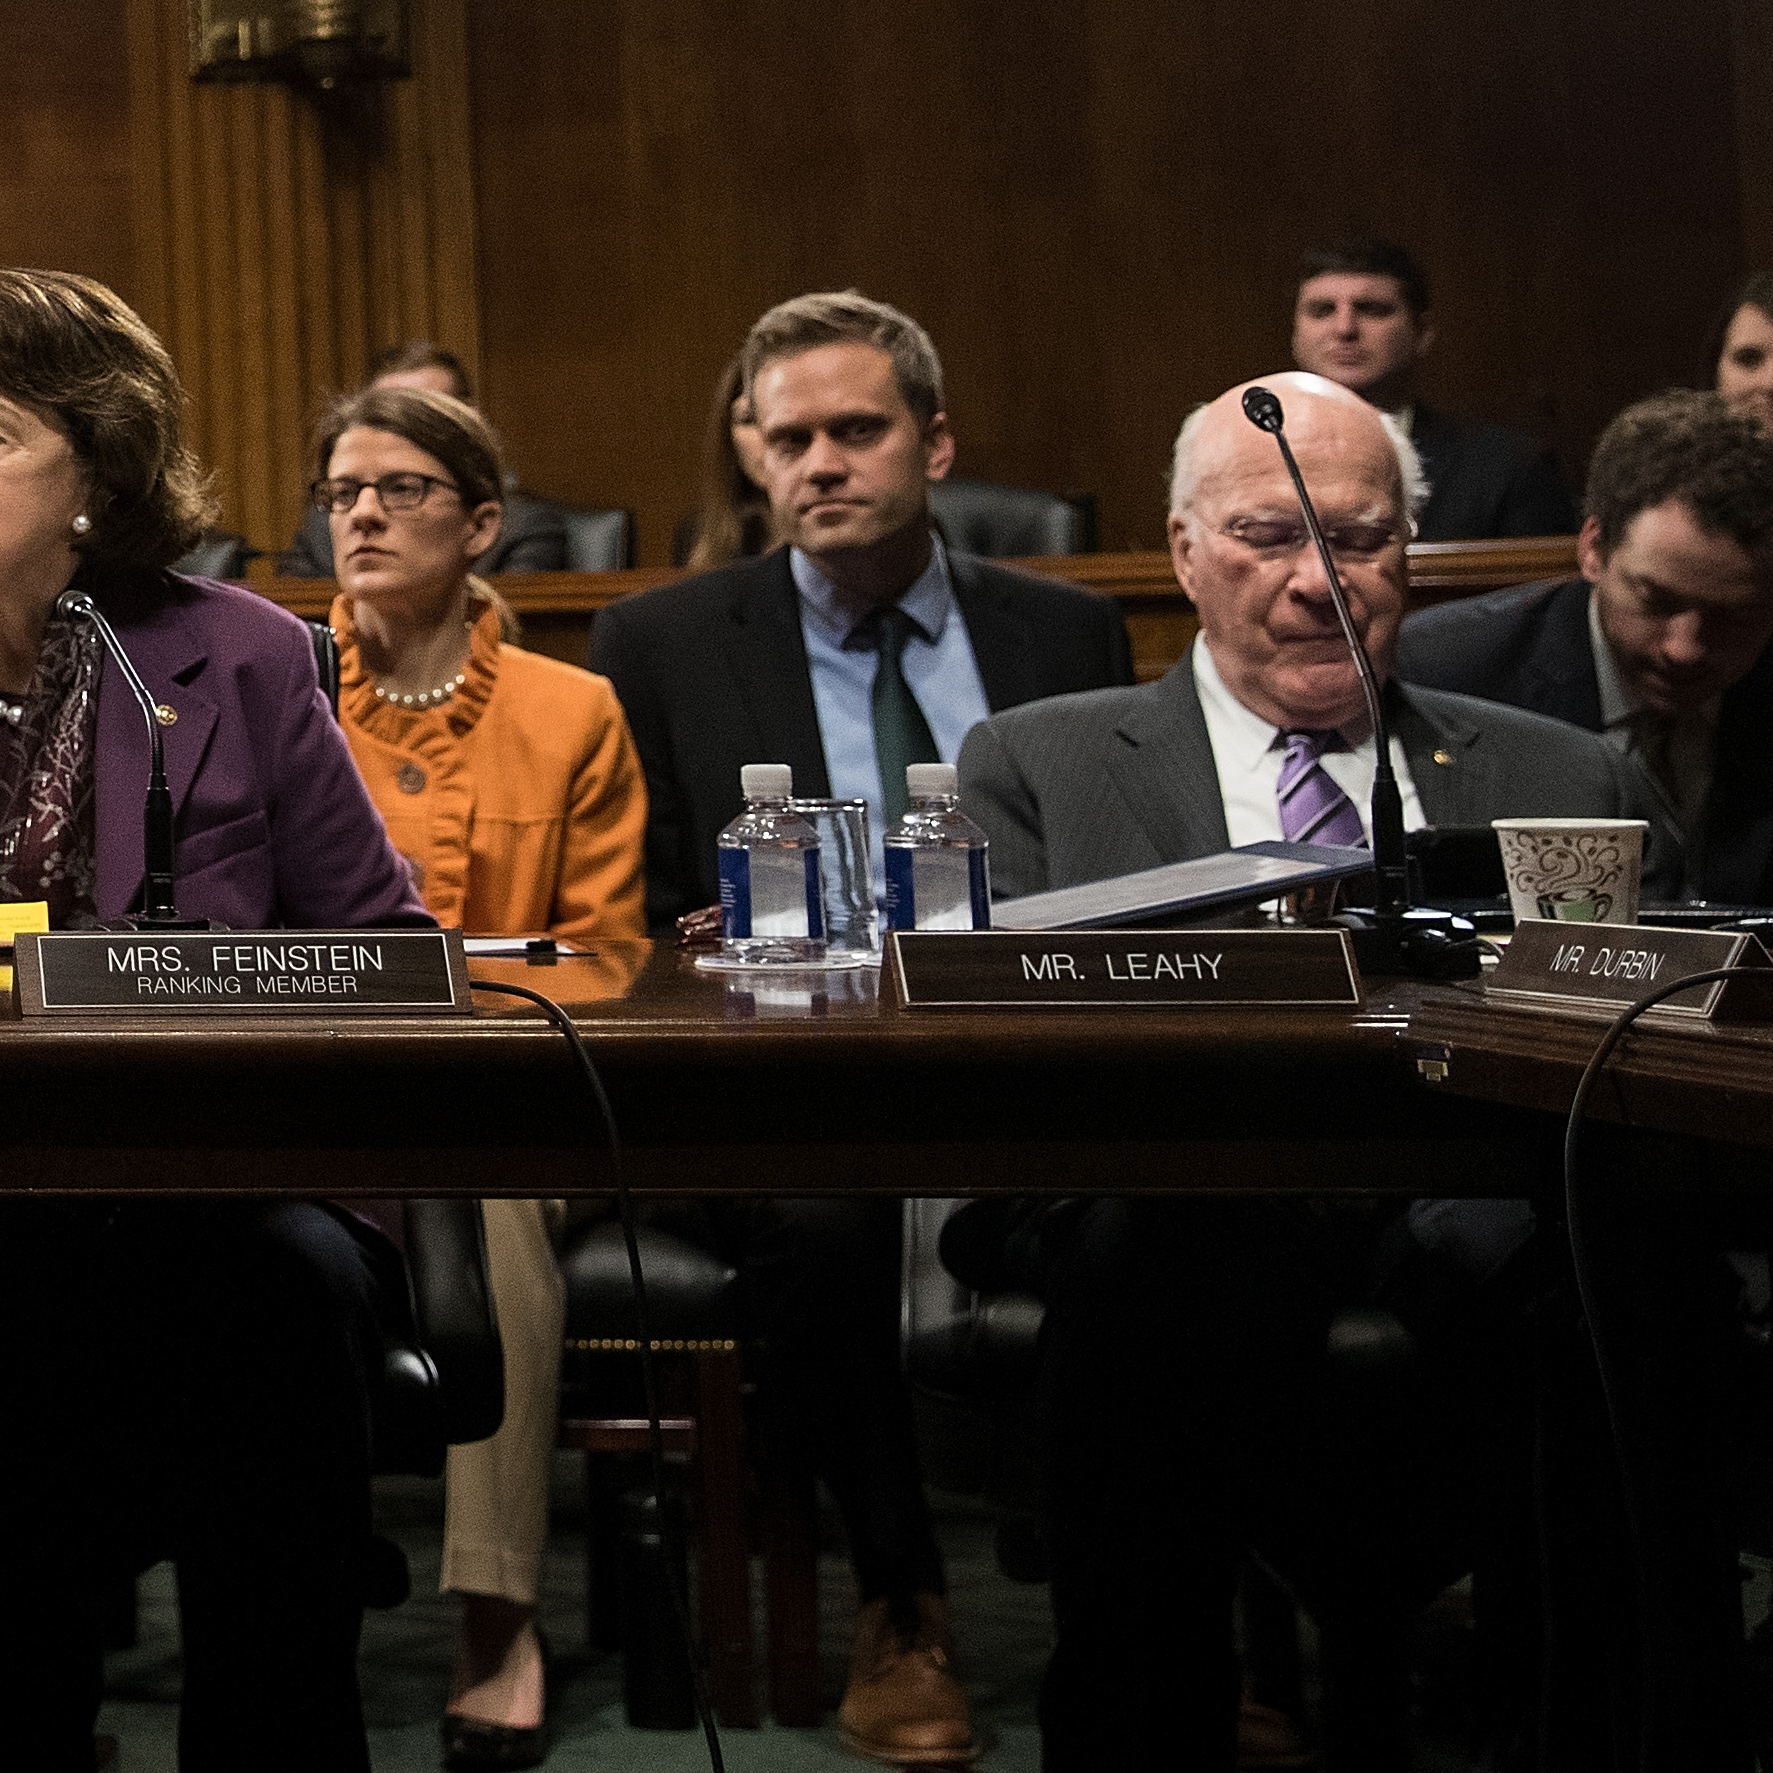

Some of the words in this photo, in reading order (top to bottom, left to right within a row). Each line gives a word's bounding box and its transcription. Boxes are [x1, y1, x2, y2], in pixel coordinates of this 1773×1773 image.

[107, 945, 191, 973] MRS.
[212, 945, 384, 972] FEINSTEIN
[1020, 953, 1086, 981] MR.
[1105, 953, 1223, 980] LEAHY
[1550, 944, 1584, 973] MR.
[1589, 947, 1665, 981] DURBIN
[137, 975, 242, 995] RANKING
[256, 975, 358, 994] MEMBER
